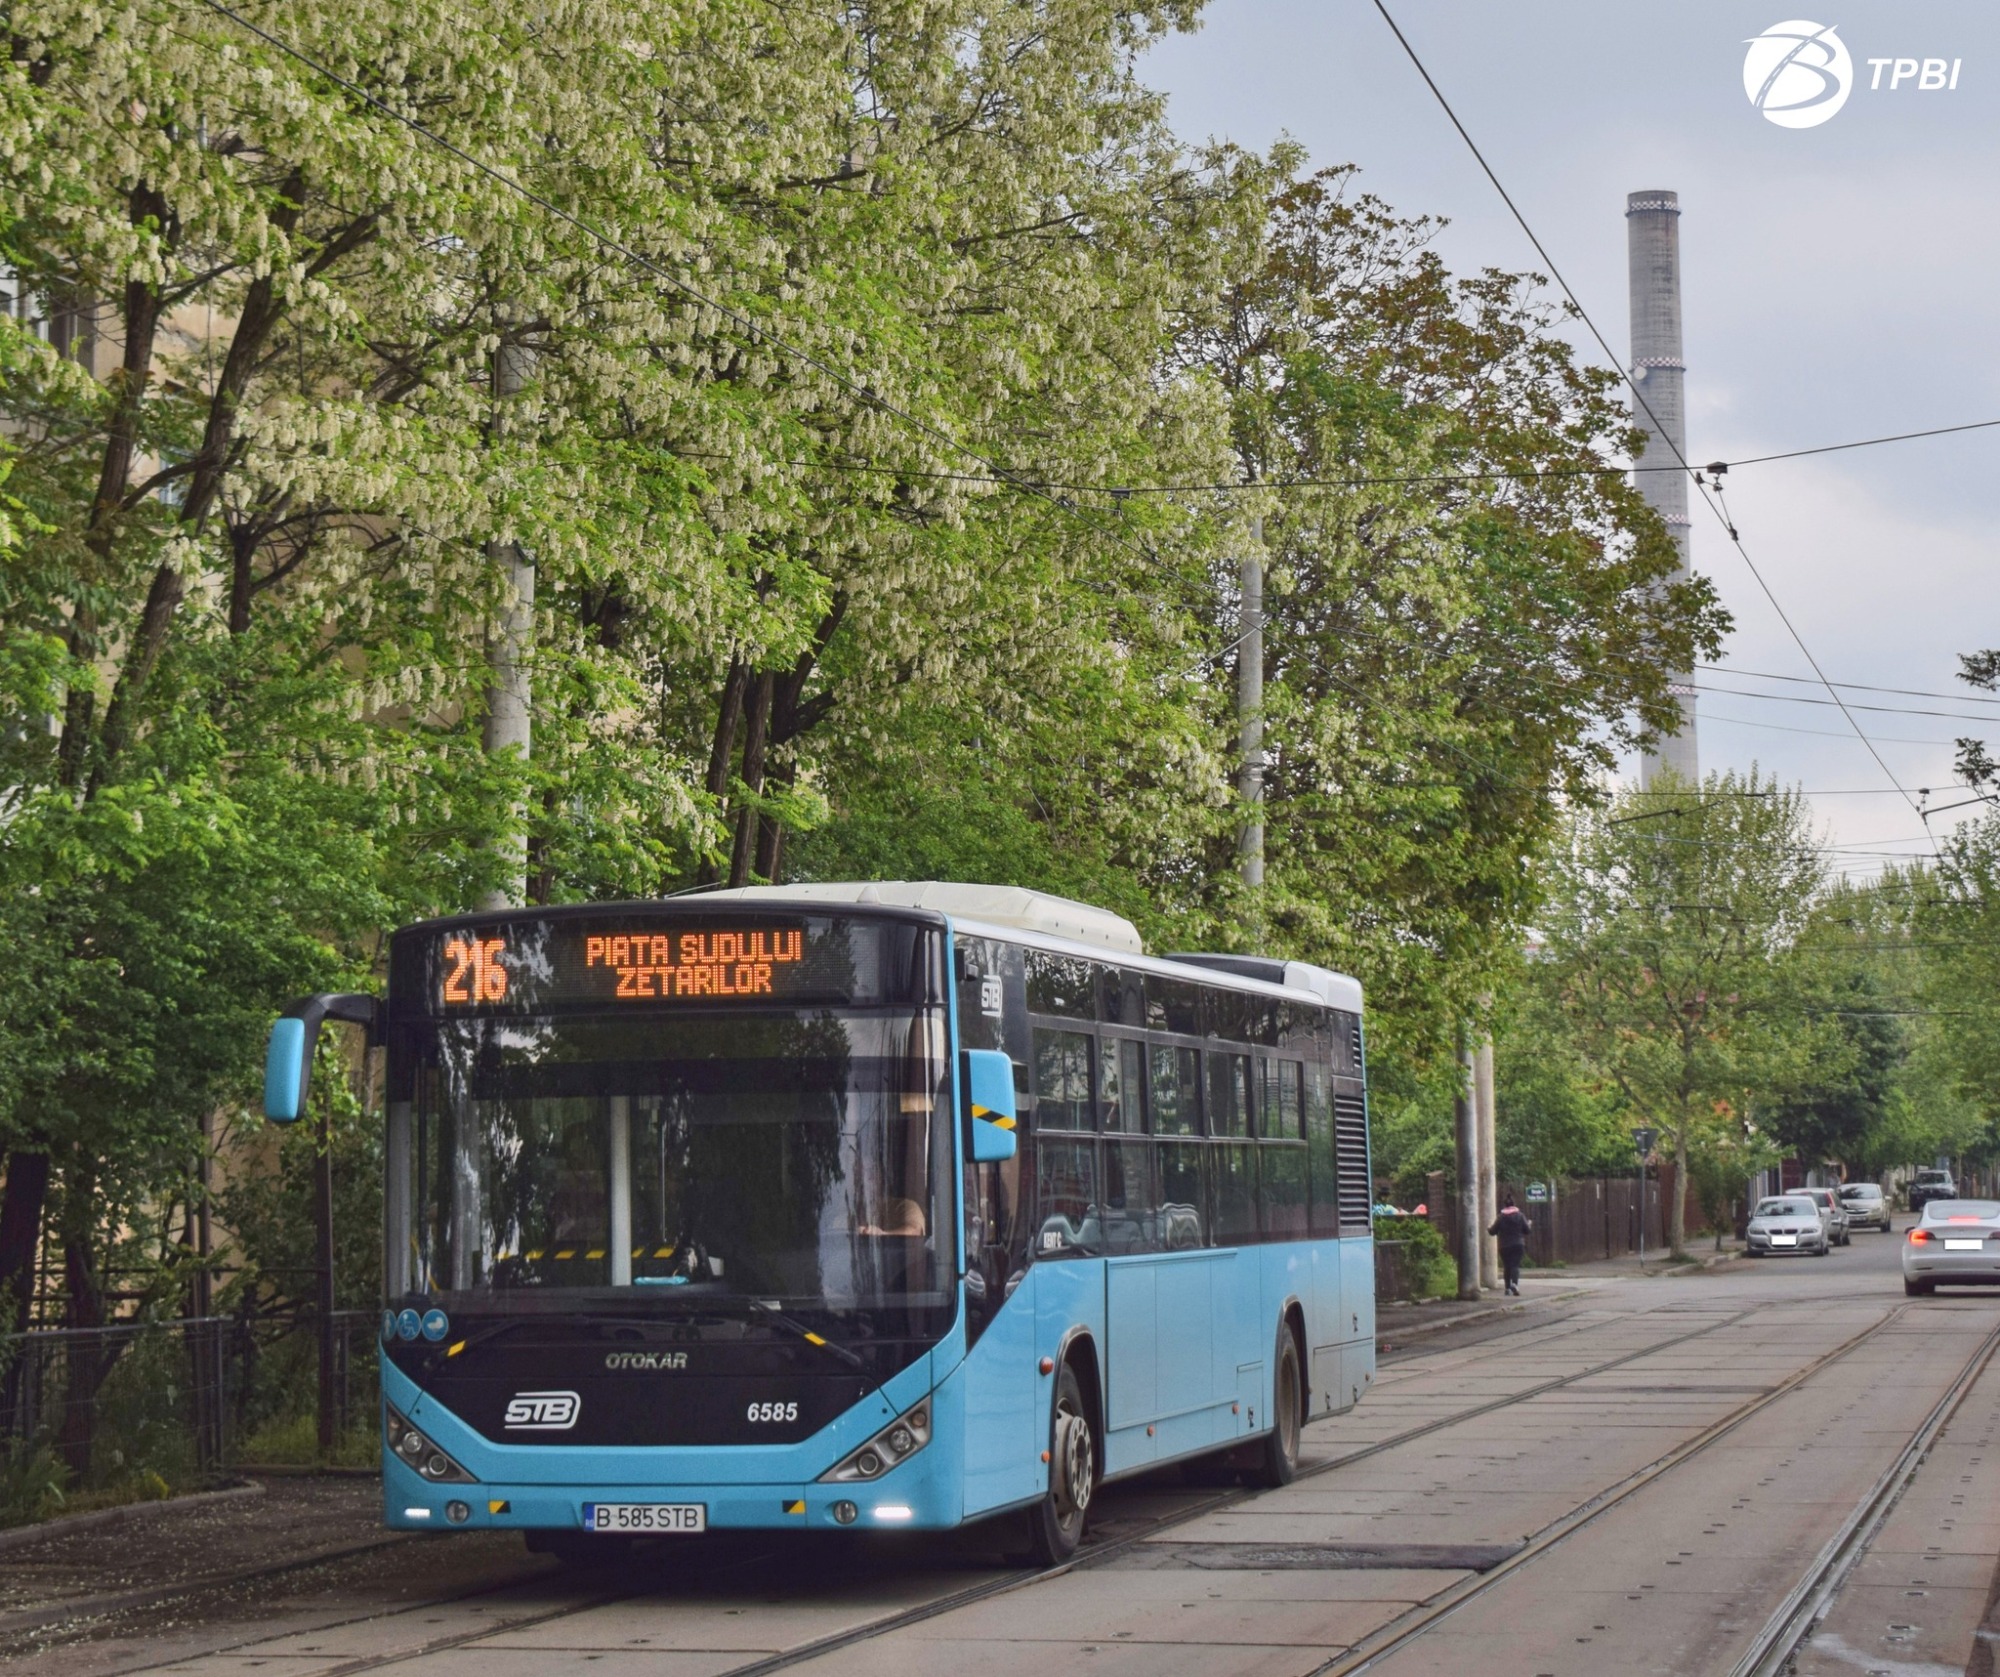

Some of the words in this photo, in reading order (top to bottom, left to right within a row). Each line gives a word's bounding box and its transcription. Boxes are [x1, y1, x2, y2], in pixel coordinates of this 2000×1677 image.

[587, 936, 668, 966] PIATA
[680, 931, 801, 963] SUDULUI
[445, 940, 506, 1001] 216
[616, 963, 772, 997] ZETARILOR
[605, 1352, 688, 1370] OTOKAR
[504, 1398, 574, 1423] STB
[747, 1402, 798, 1422] 6585
[596, 1507, 611, 1528] B
[618, 1507, 654, 1528] 585
[657, 1507, 698, 1528] STB
